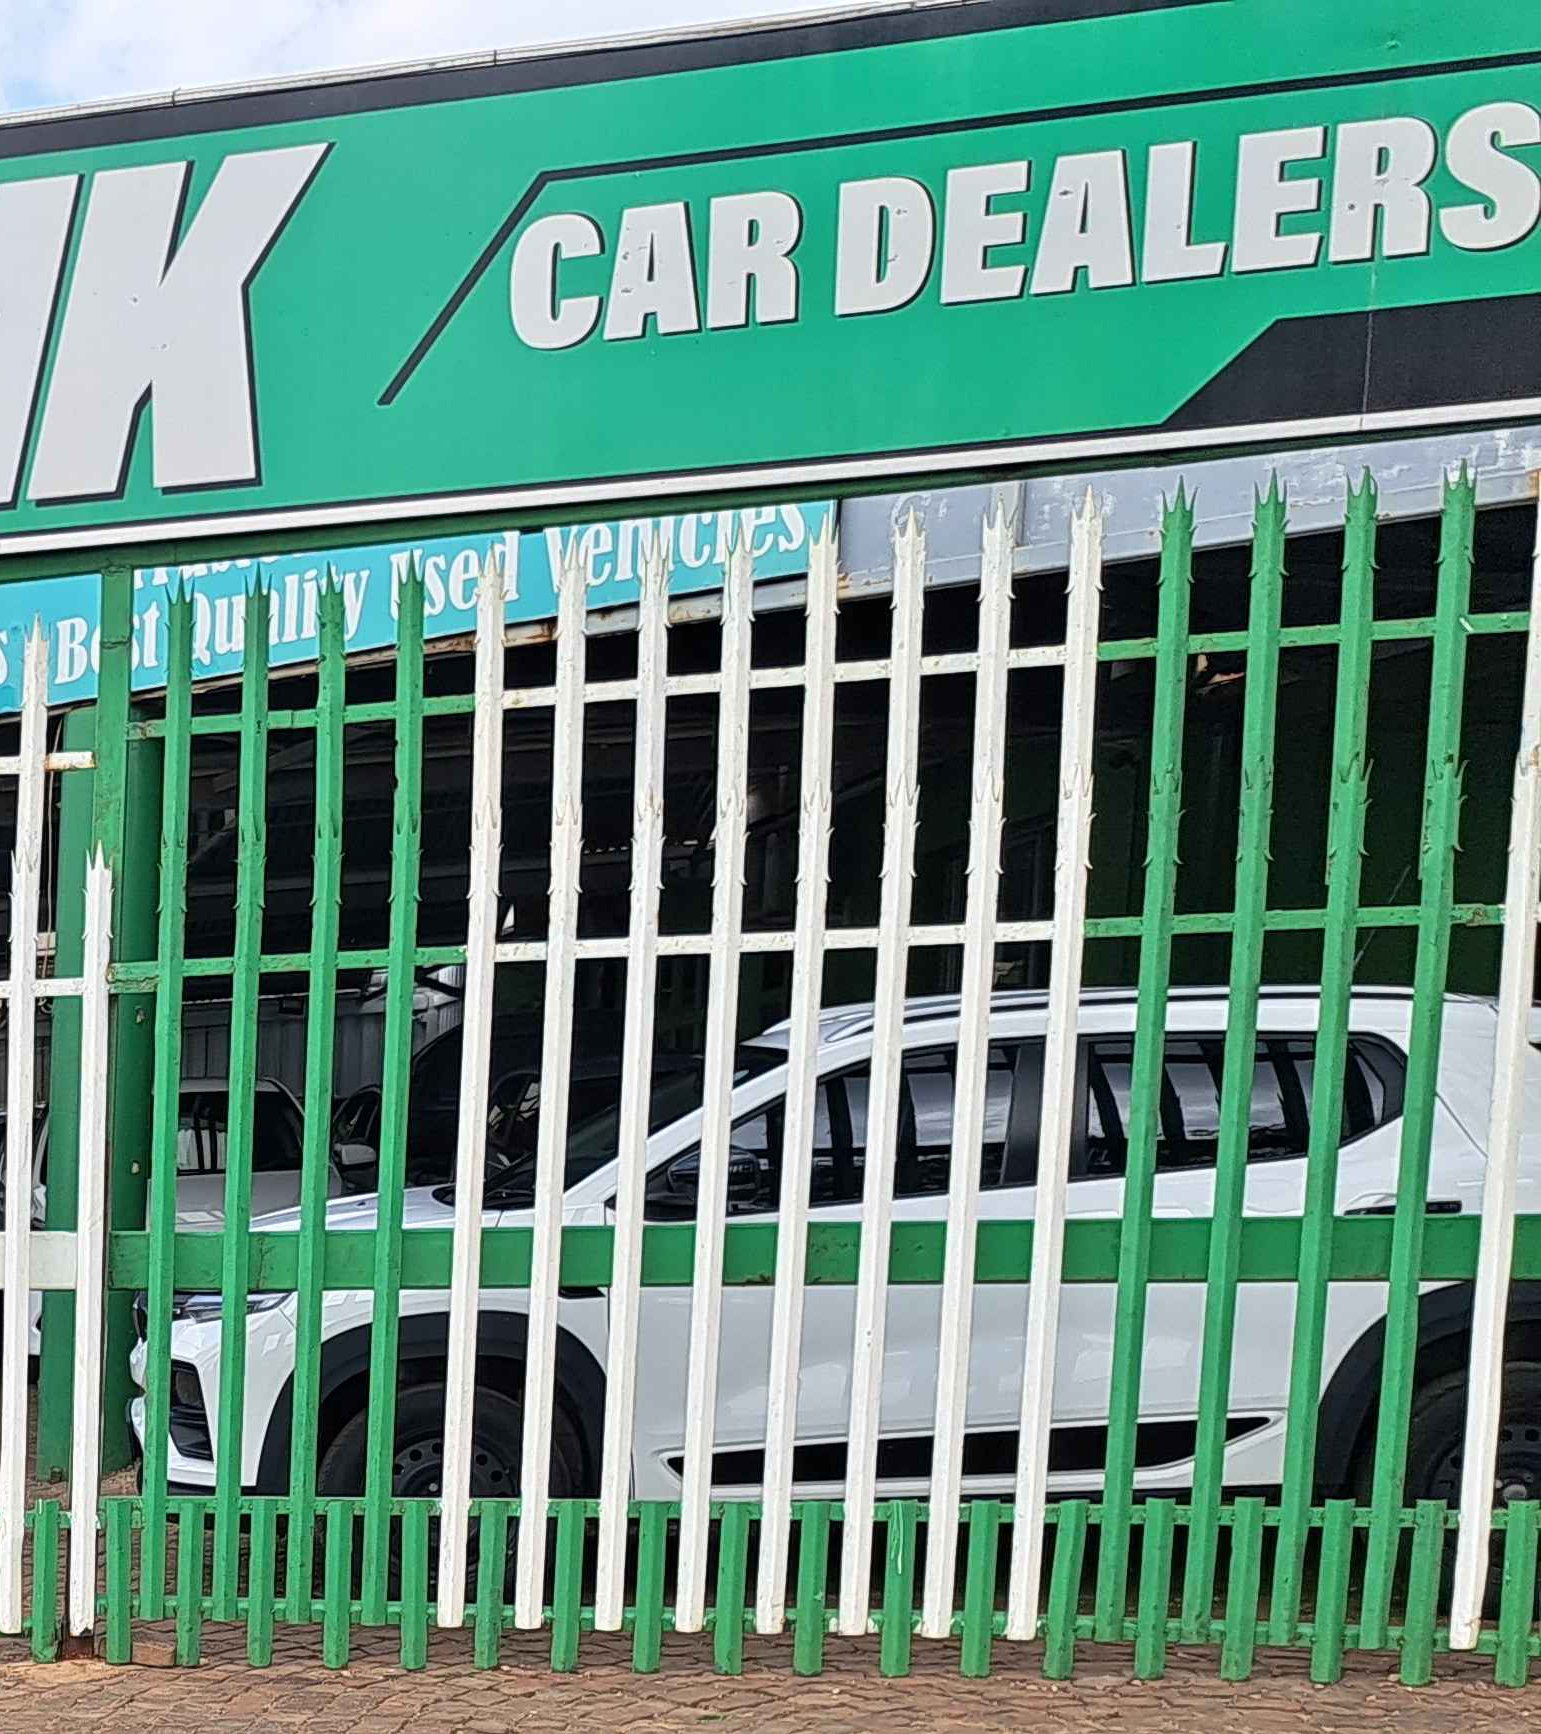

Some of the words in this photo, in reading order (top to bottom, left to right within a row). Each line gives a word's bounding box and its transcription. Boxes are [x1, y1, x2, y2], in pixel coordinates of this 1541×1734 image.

[509, 189, 803, 350] CAR
[834, 100, 1541, 318] DEALERS
[54, 600, 162, 686] Bst
[189, 568, 371, 666] Quliy
